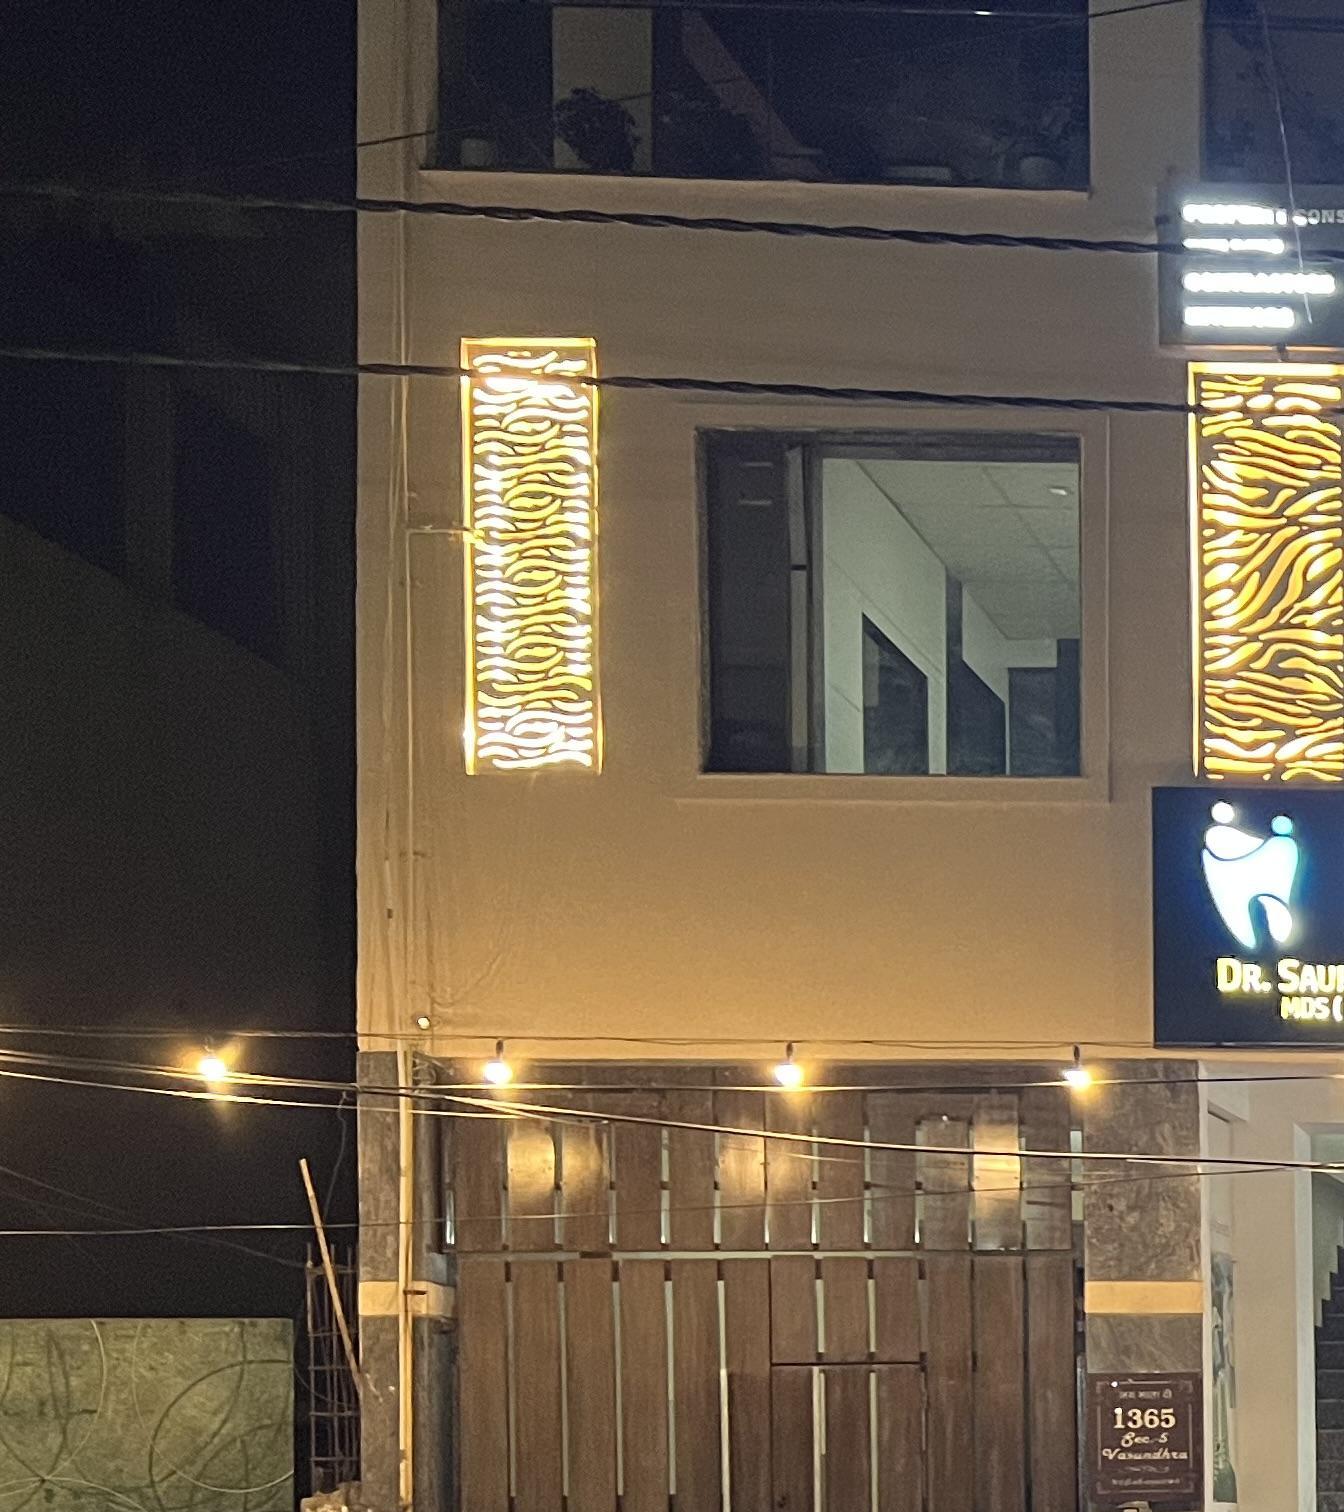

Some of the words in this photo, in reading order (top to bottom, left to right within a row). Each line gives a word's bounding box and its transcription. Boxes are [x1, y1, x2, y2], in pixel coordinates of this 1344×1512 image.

[1216, 957, 1271, 993] DR.
[1281, 996, 1330, 1020] MDS
[1113, 1407, 1176, 1429] 1365
